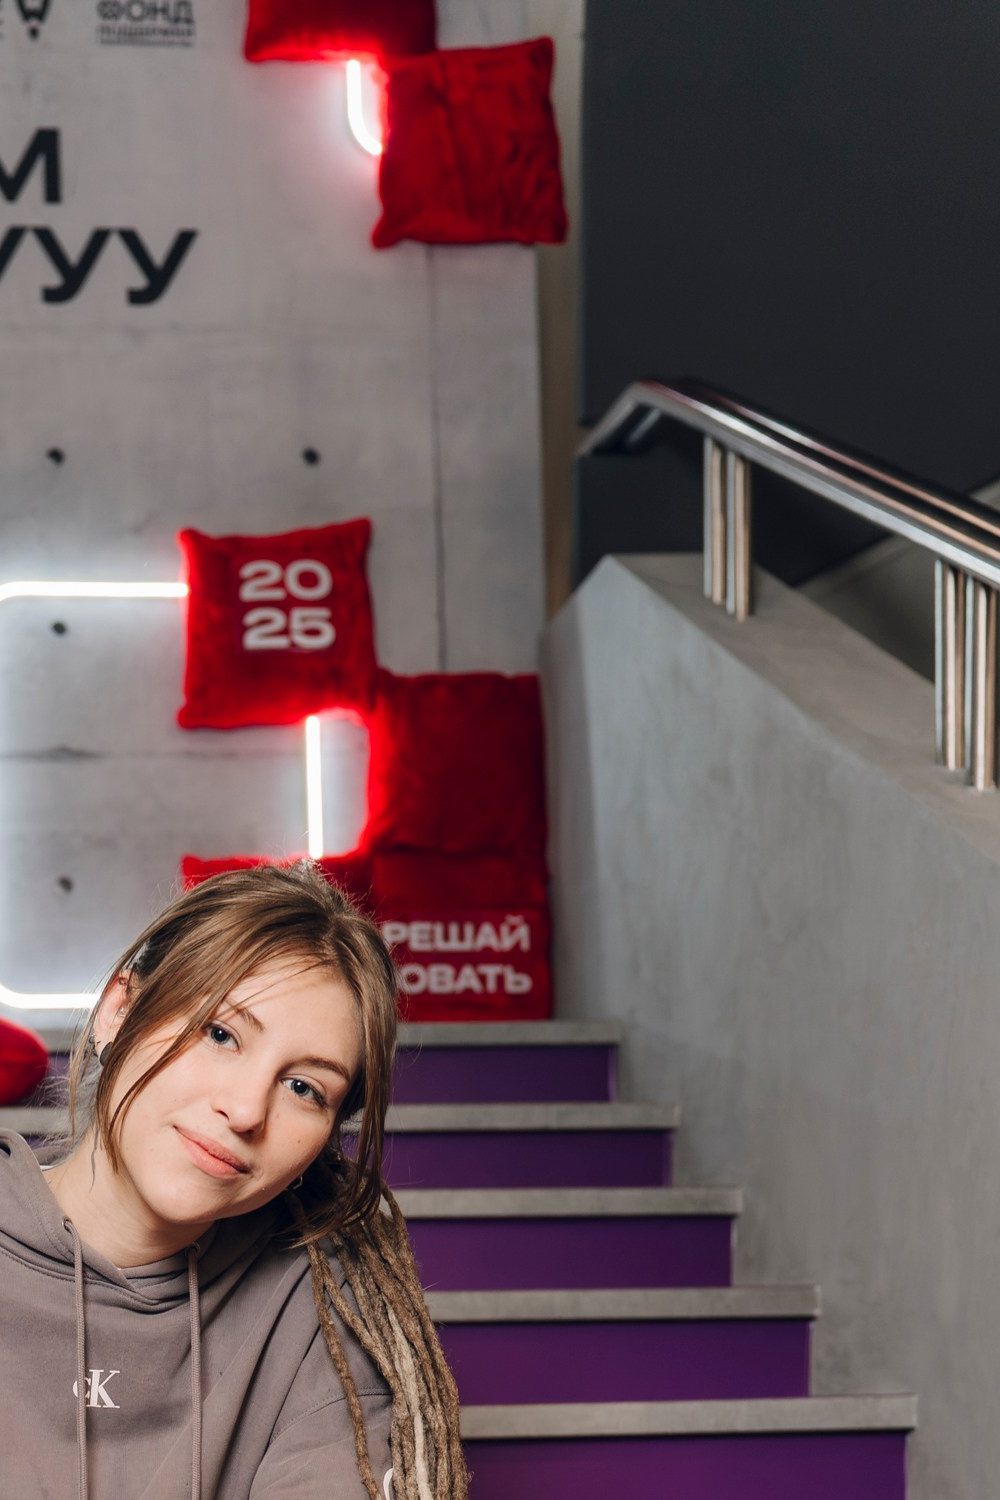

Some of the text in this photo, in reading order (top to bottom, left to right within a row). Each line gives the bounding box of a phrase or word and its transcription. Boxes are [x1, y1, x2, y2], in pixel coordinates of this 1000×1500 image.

[239, 559, 333, 601] 20
[243, 607, 336, 650] 25
[383, 915, 530, 952] РЕШАЙ
